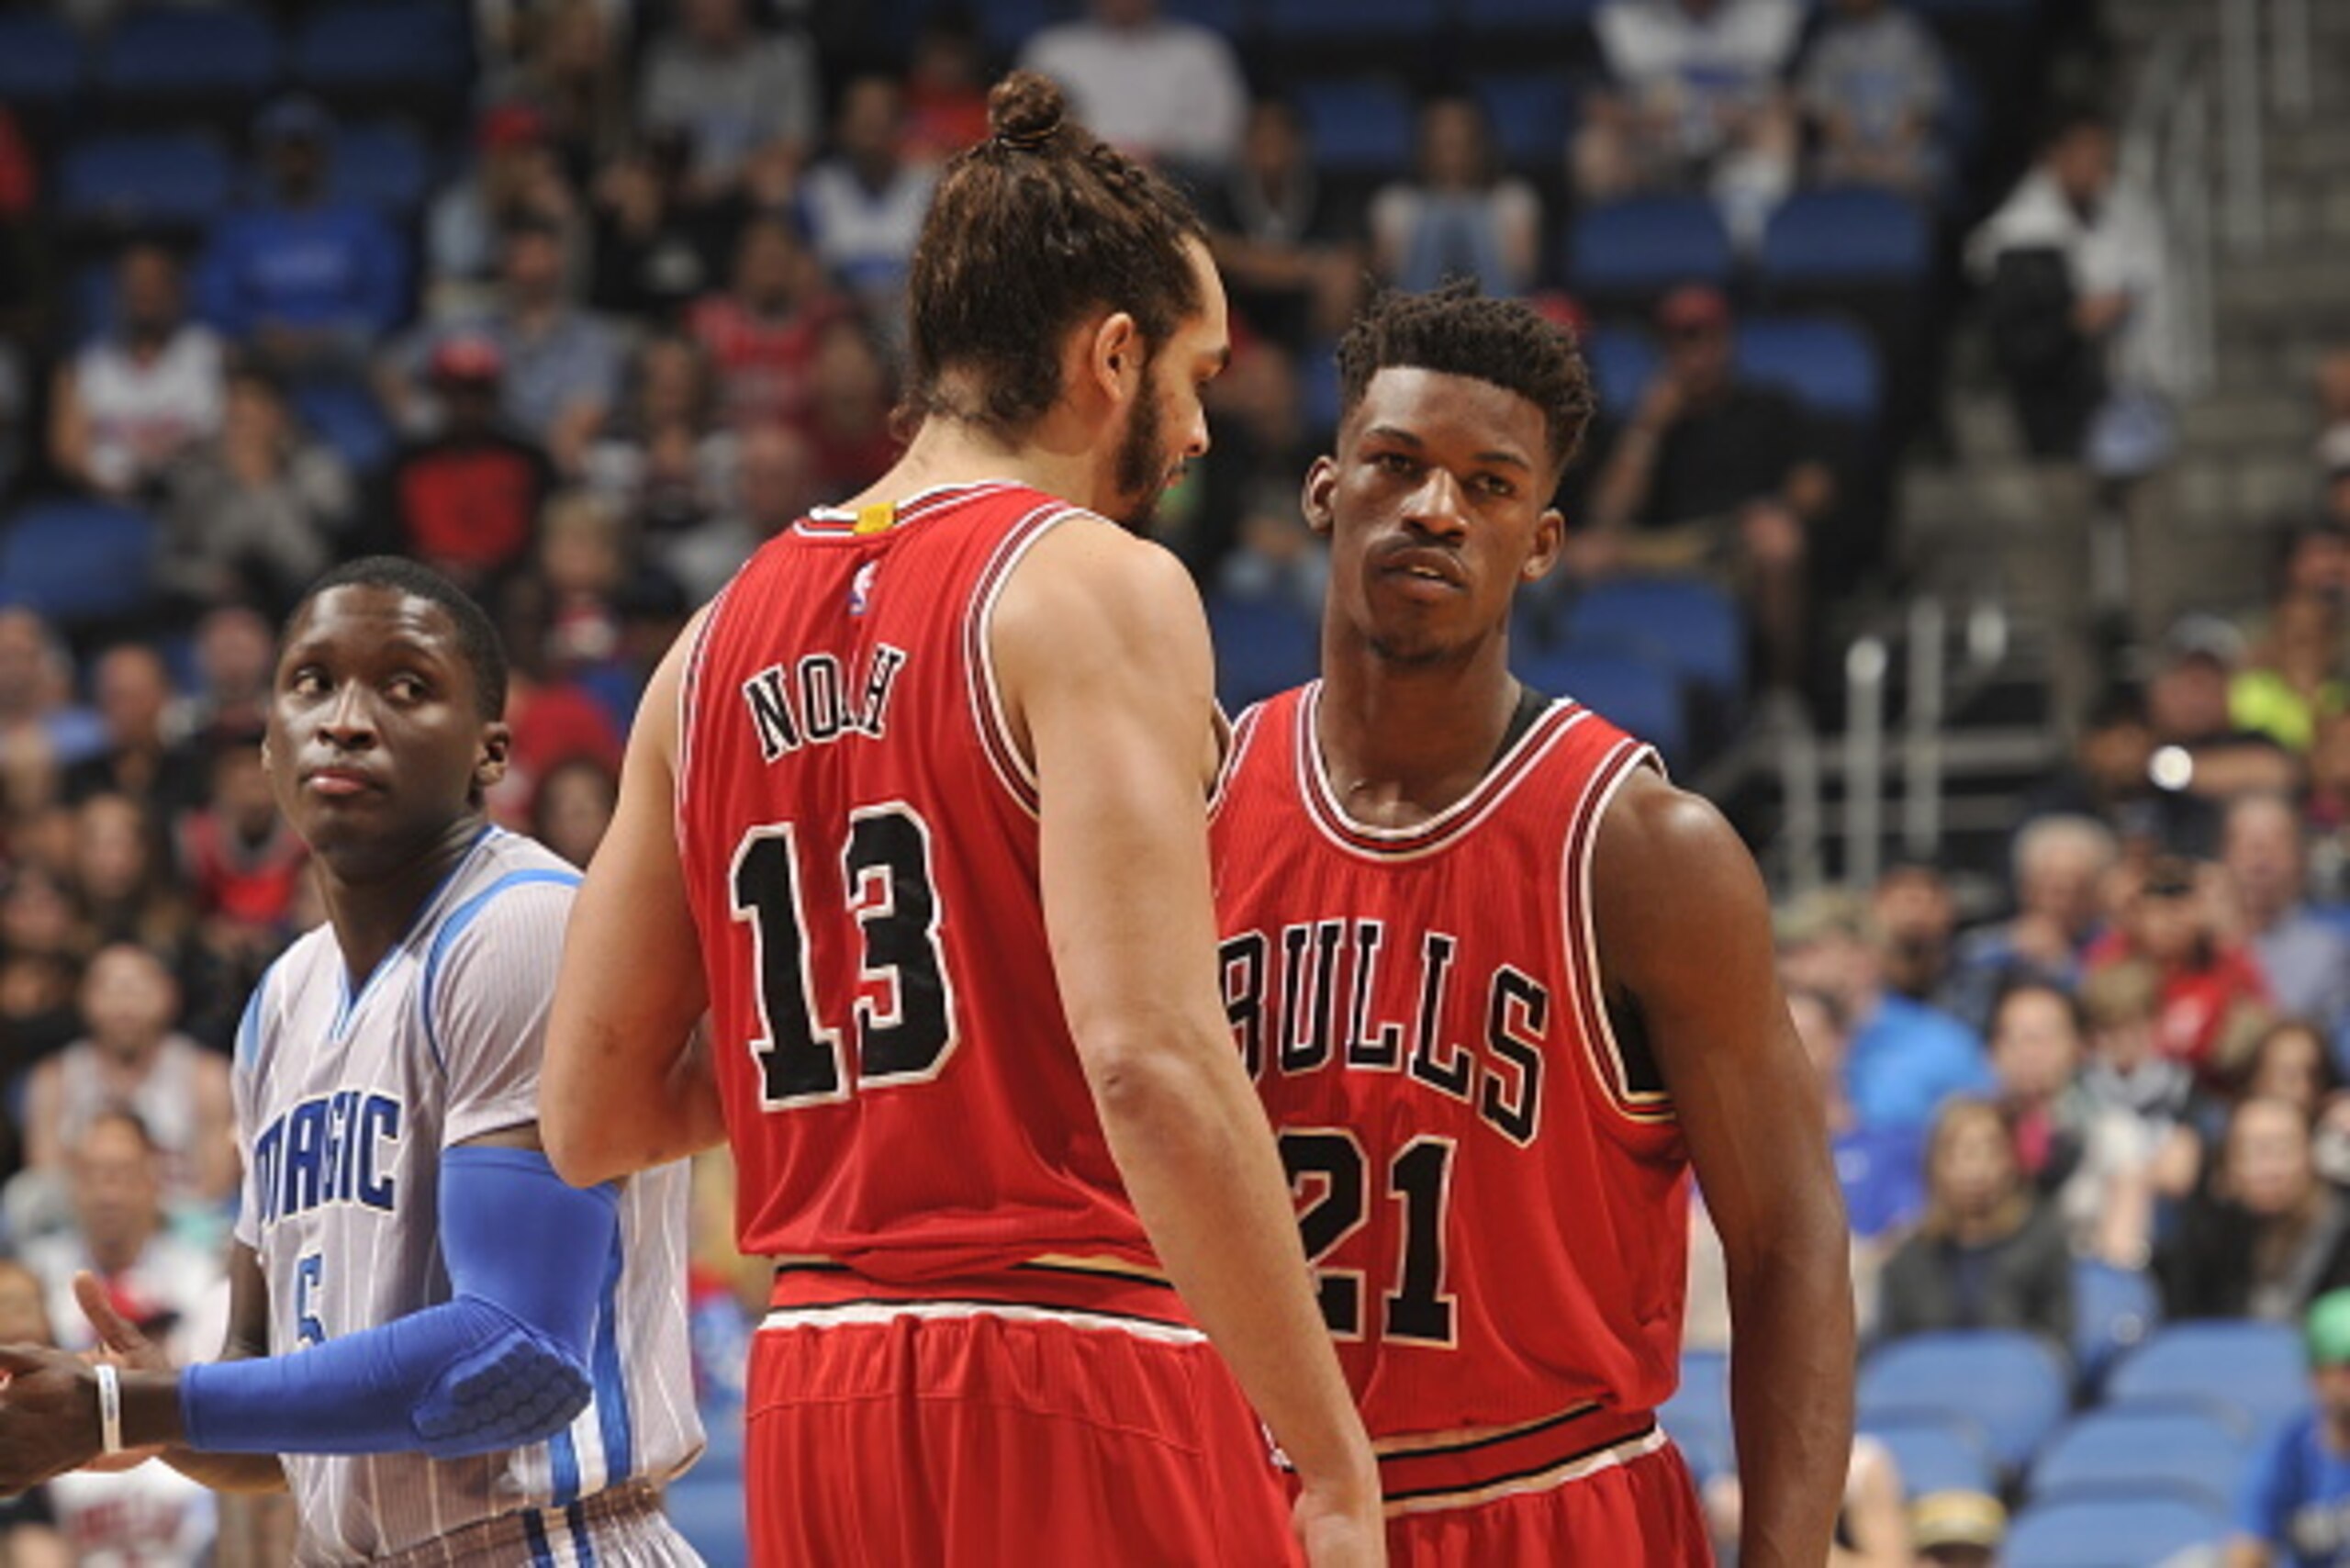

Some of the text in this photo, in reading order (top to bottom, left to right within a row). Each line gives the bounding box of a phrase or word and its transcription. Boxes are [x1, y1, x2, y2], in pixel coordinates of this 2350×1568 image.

[730, 800, 960, 1112] 13
[1218, 917, 1550, 1148] BULLS
[1278, 1126, 1458, 1350] 21
